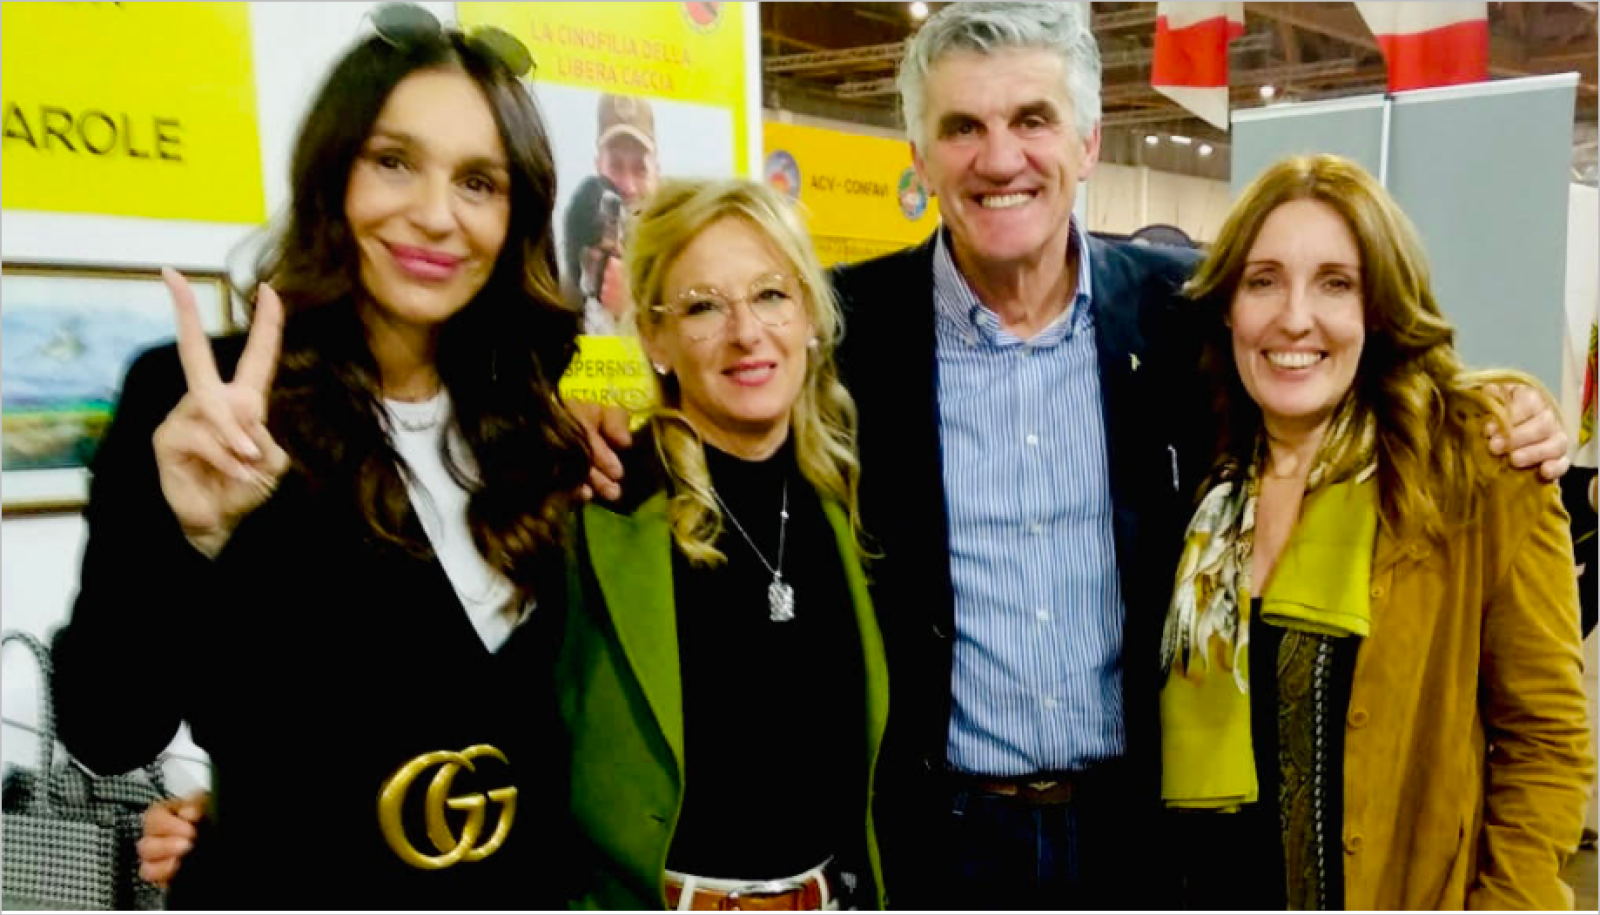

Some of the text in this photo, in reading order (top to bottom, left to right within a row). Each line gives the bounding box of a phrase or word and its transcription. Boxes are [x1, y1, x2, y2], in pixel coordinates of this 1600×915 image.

[530, 19, 692, 66] LA CINOFILIA DELLA
[556, 55, 676, 93] LIBERA CACCIA
[2, 101, 183, 163] AROLE
